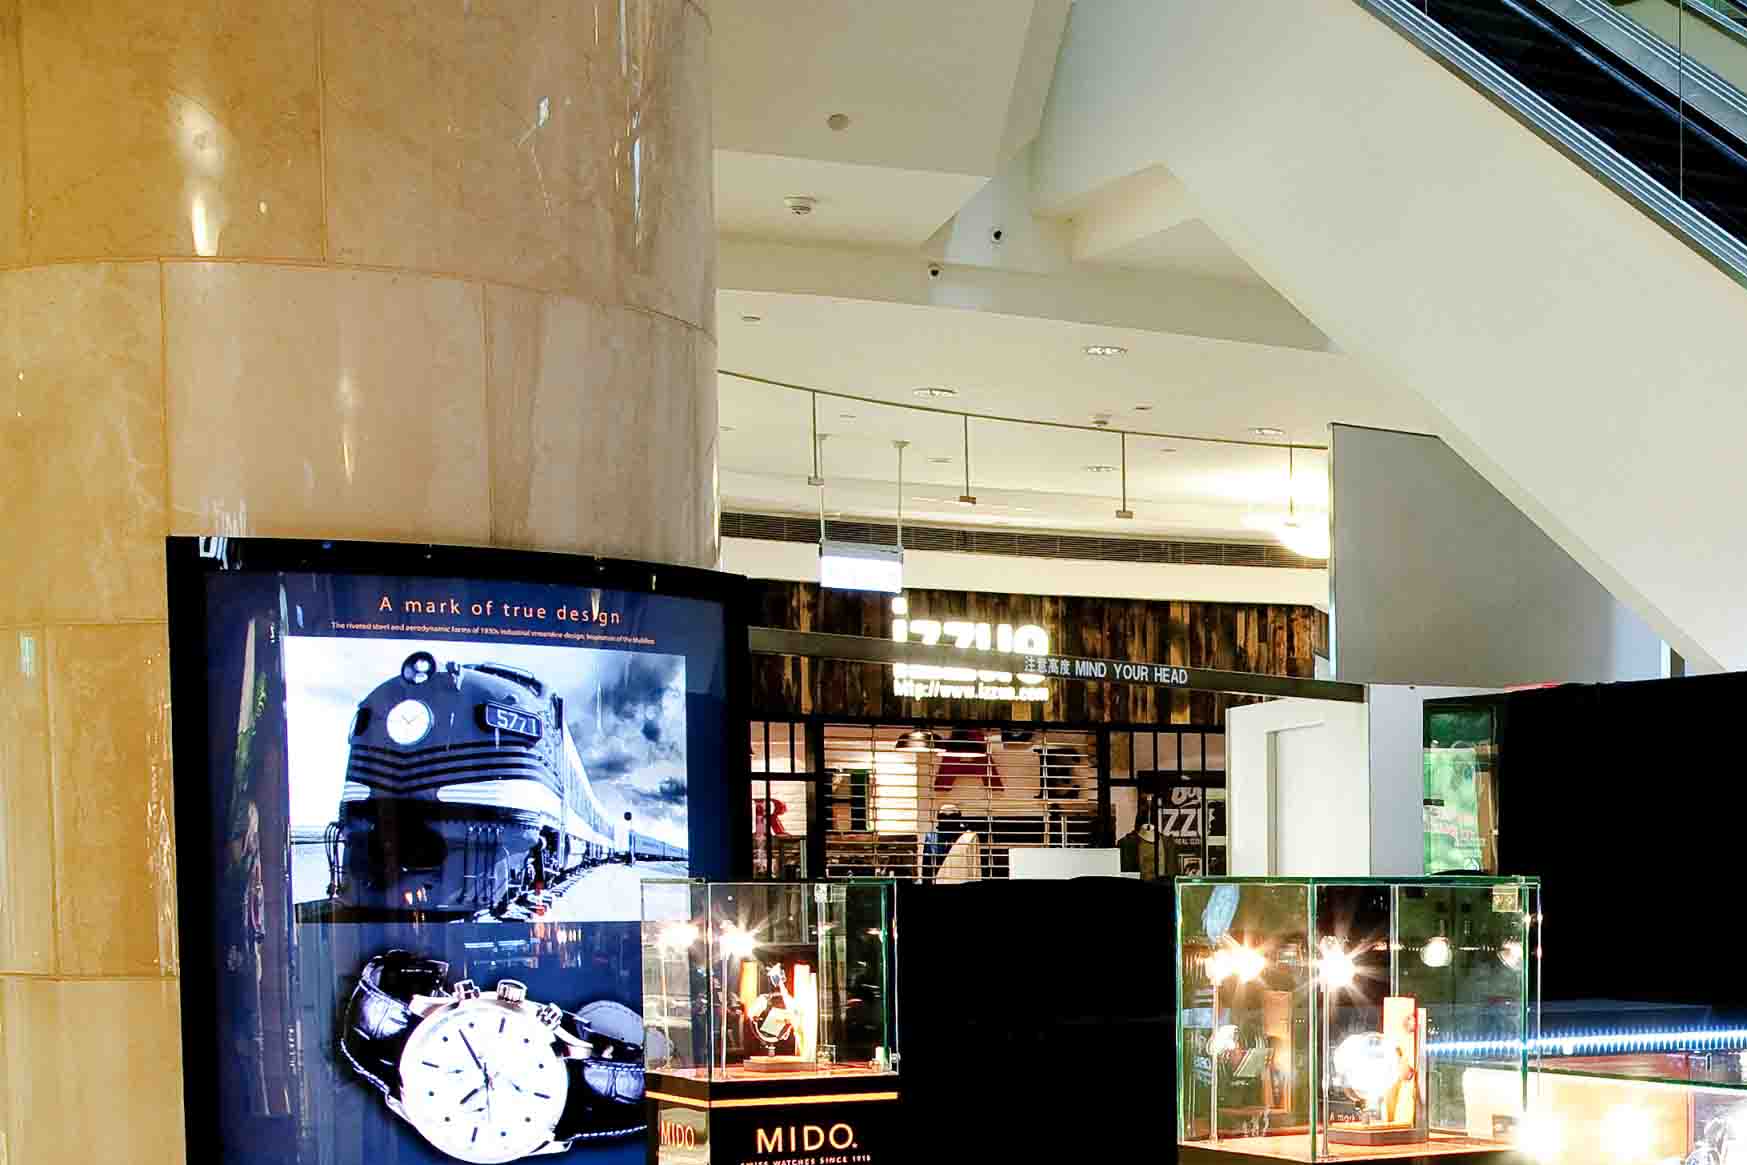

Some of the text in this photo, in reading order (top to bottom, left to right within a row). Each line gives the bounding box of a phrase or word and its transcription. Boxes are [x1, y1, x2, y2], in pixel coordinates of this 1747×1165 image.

[379, 597, 619, 626] A mark of true design
[1024, 655, 1071, 676] 注意高度
[1075, 662, 1188, 684] MIND YOUR HEAD
[660, 1120, 694, 1150] MIDO
[756, 1123, 854, 1153] MIDO
[820, 1156, 848, 1165] SINCE
